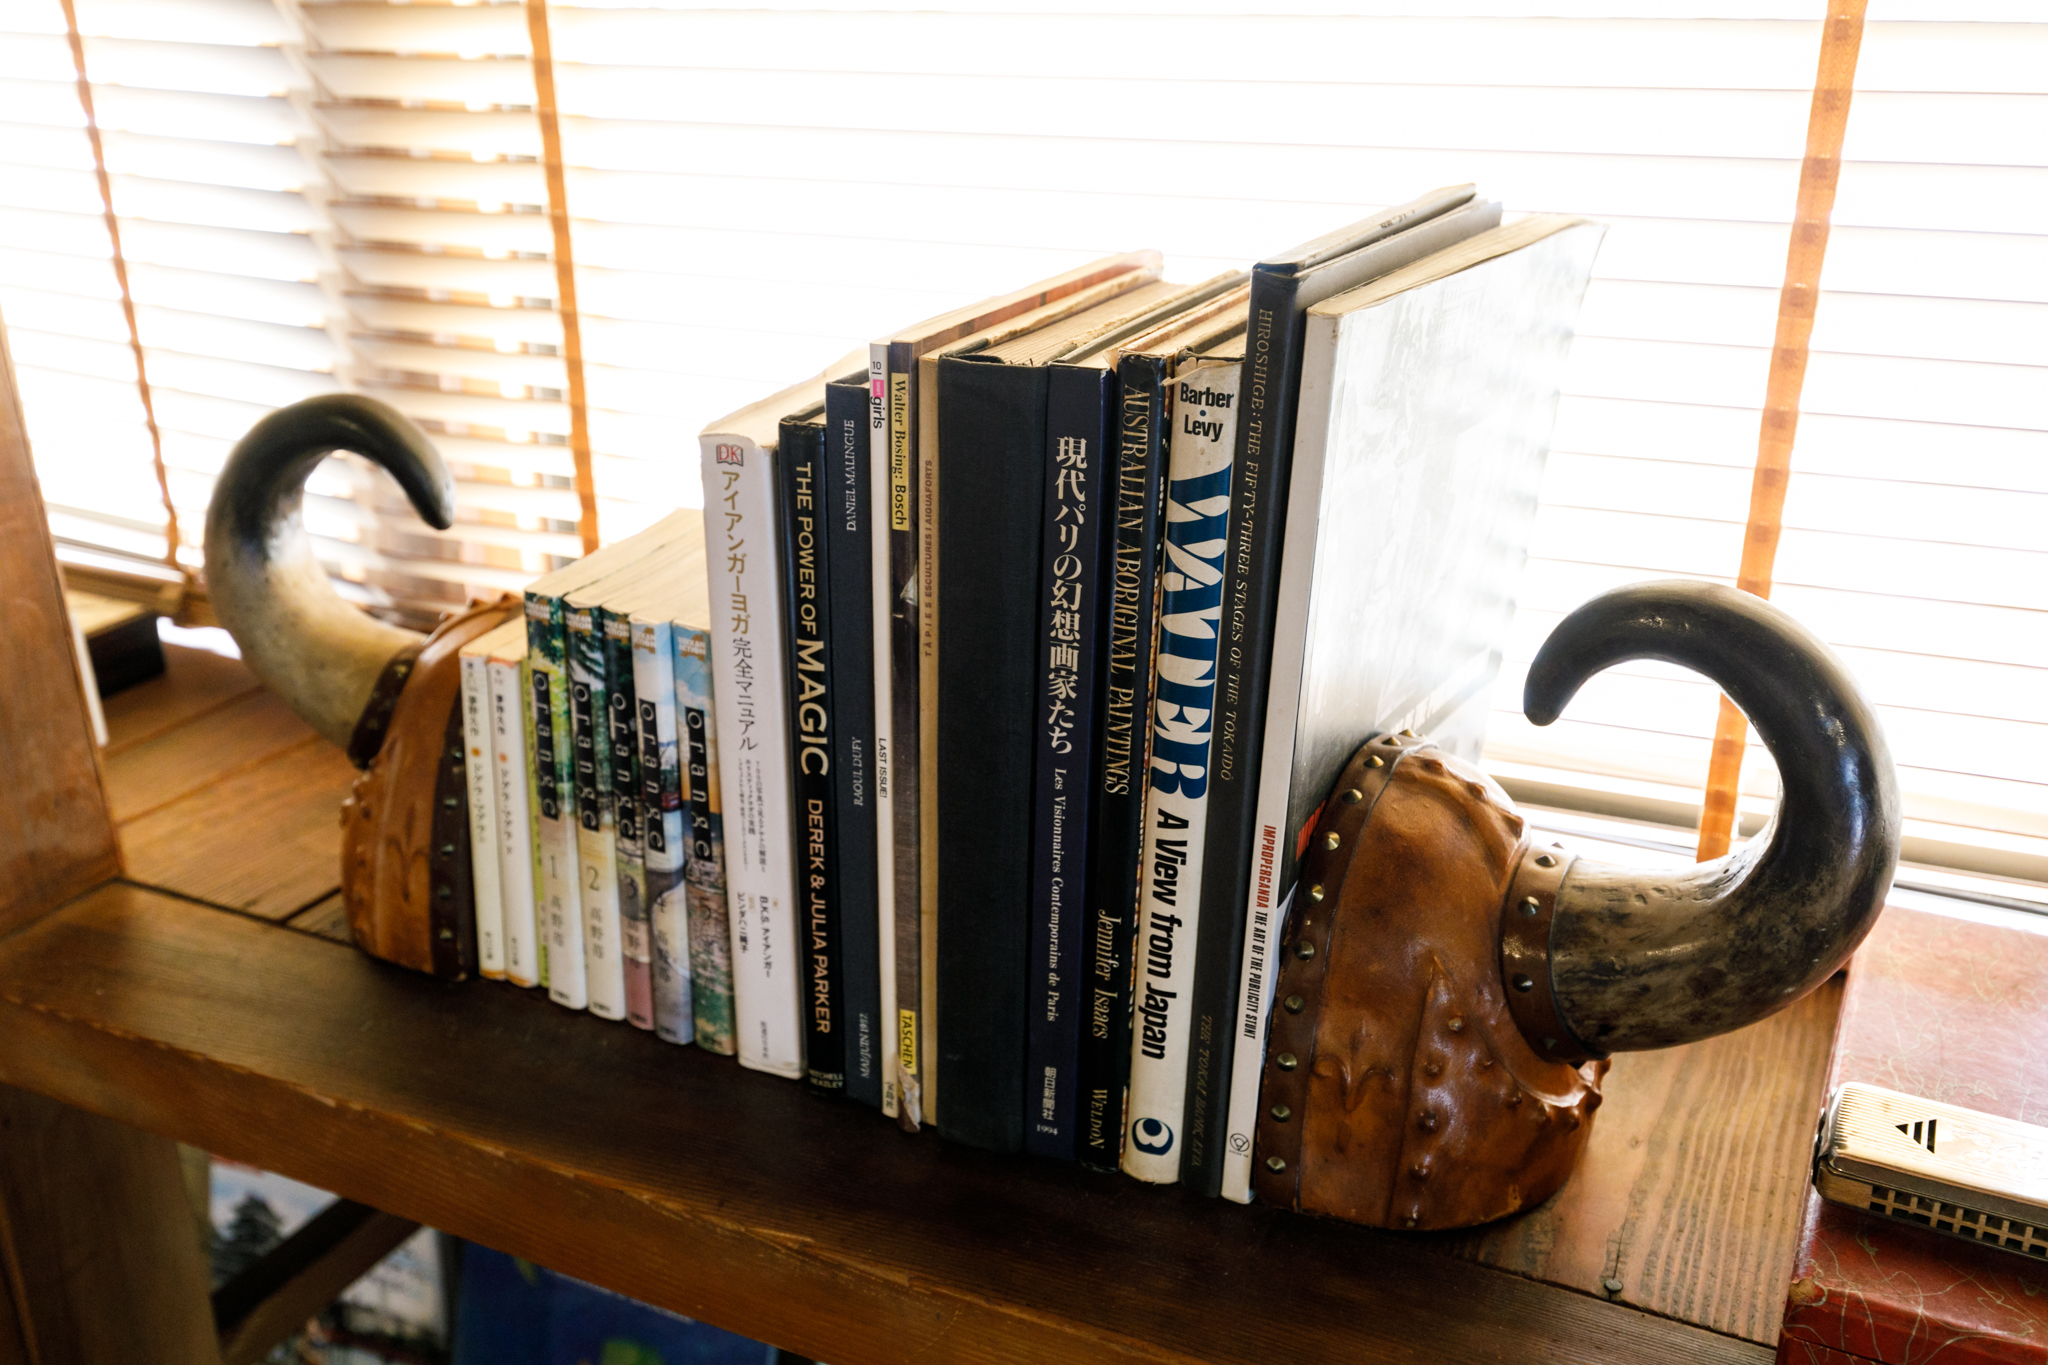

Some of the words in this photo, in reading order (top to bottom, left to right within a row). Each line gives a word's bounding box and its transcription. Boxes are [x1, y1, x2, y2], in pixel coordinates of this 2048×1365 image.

[872, 361, 882, 370] 10
[1252, 308, 1273, 417] HIROSHIGE:
[870, 396, 885, 429] girls
[894, 380, 907, 426] Walter
[1180, 382, 1235, 409] Barber
[718, 444, 741, 463] DK
[843, 419, 856, 487] MALINGUE
[1183, 414, 1224, 443] Levy
[1247, 420, 1262, 455] THE
[892, 430, 907, 480] Bosing:
[1117, 384, 1150, 534] AUSTRALIAN
[796, 462, 812, 511] THE
[845, 489, 857, 531] DANIEL
[894, 484, 907, 525] Bosch
[924, 460, 933, 524] AIGUAFORTS
[1238, 462, 1259, 575] FIFTY-THREE
[722, 470, 751, 634] アイアンガーヨガ
[797, 516, 816, 600] POWER
[925, 534, 933, 598] ESCULTURES
[800, 604, 817, 635] OF
[1047, 436, 1087, 754] 現代パリの幻想画家たち
[1110, 538, 1142, 675] ABORIGINAL
[1231, 579, 1249, 642] STAGES
[1150, 462, 1233, 801] WATER
[1229, 646, 1242, 669] OF
[732, 636, 758, 751] 完全マニュアル
[796, 638, 829, 777] MAGIC
[1226, 673, 1240, 705] THE
[533, 673, 556, 816] orange
[574, 684, 597, 827] orange
[851, 737, 863, 768] DUFY
[878, 737, 887, 764] LAST
[1104, 682, 1135, 796] PAINTINGS
[612, 693, 634, 836] orange
[640, 703, 663, 848] orange
[687, 711, 711, 857] orange
[853, 769, 864, 806] RAOUL
[879, 766, 888, 798] ISSUE!
[1055, 767, 1067, 790] Les
[807, 799, 825, 871] DEREK
[1052, 795, 1067, 873] Visionnaires
[1157, 807, 1189, 829] A
[586, 866, 600, 892] 2
[624, 874, 638, 899] 3
[810, 875, 825, 889] &
[1152, 838, 1188, 907] View
[1256, 825, 1277, 909] IMPROPERGANDA
[811, 893, 828, 950] JULIA
[1049, 877, 1064, 969] Contemporains
[1252, 928, 1266, 944] ART
[1254, 910, 1268, 926] THE
[1095, 909, 1122, 981] Jennifer
[1147, 912, 1183, 979] from
[1250, 956, 1263, 972] THE
[1251, 944, 1264, 956] OF
[813, 954, 831, 1034] PARKER
[1048, 971, 1061, 986] de
[1245, 971, 1262, 1016] PUBLICITY
[1047, 991, 1060, 1022] Paris
[1092, 988, 1118, 1039] Isaacs
[1138, 982, 1177, 1061] Japan
[1200, 1016, 1212, 1044] THE
[1244, 1014, 1258, 1040] STUNT
[902, 1015, 913, 1069] TASCHEN
[1042, 1066, 1057, 1120] 朝日新聞社
[1197, 1049, 1211, 1097] TOKAI
[1036, 1123, 1058, 1136] 1994
[1089, 1089, 1108, 1149] WELDON
